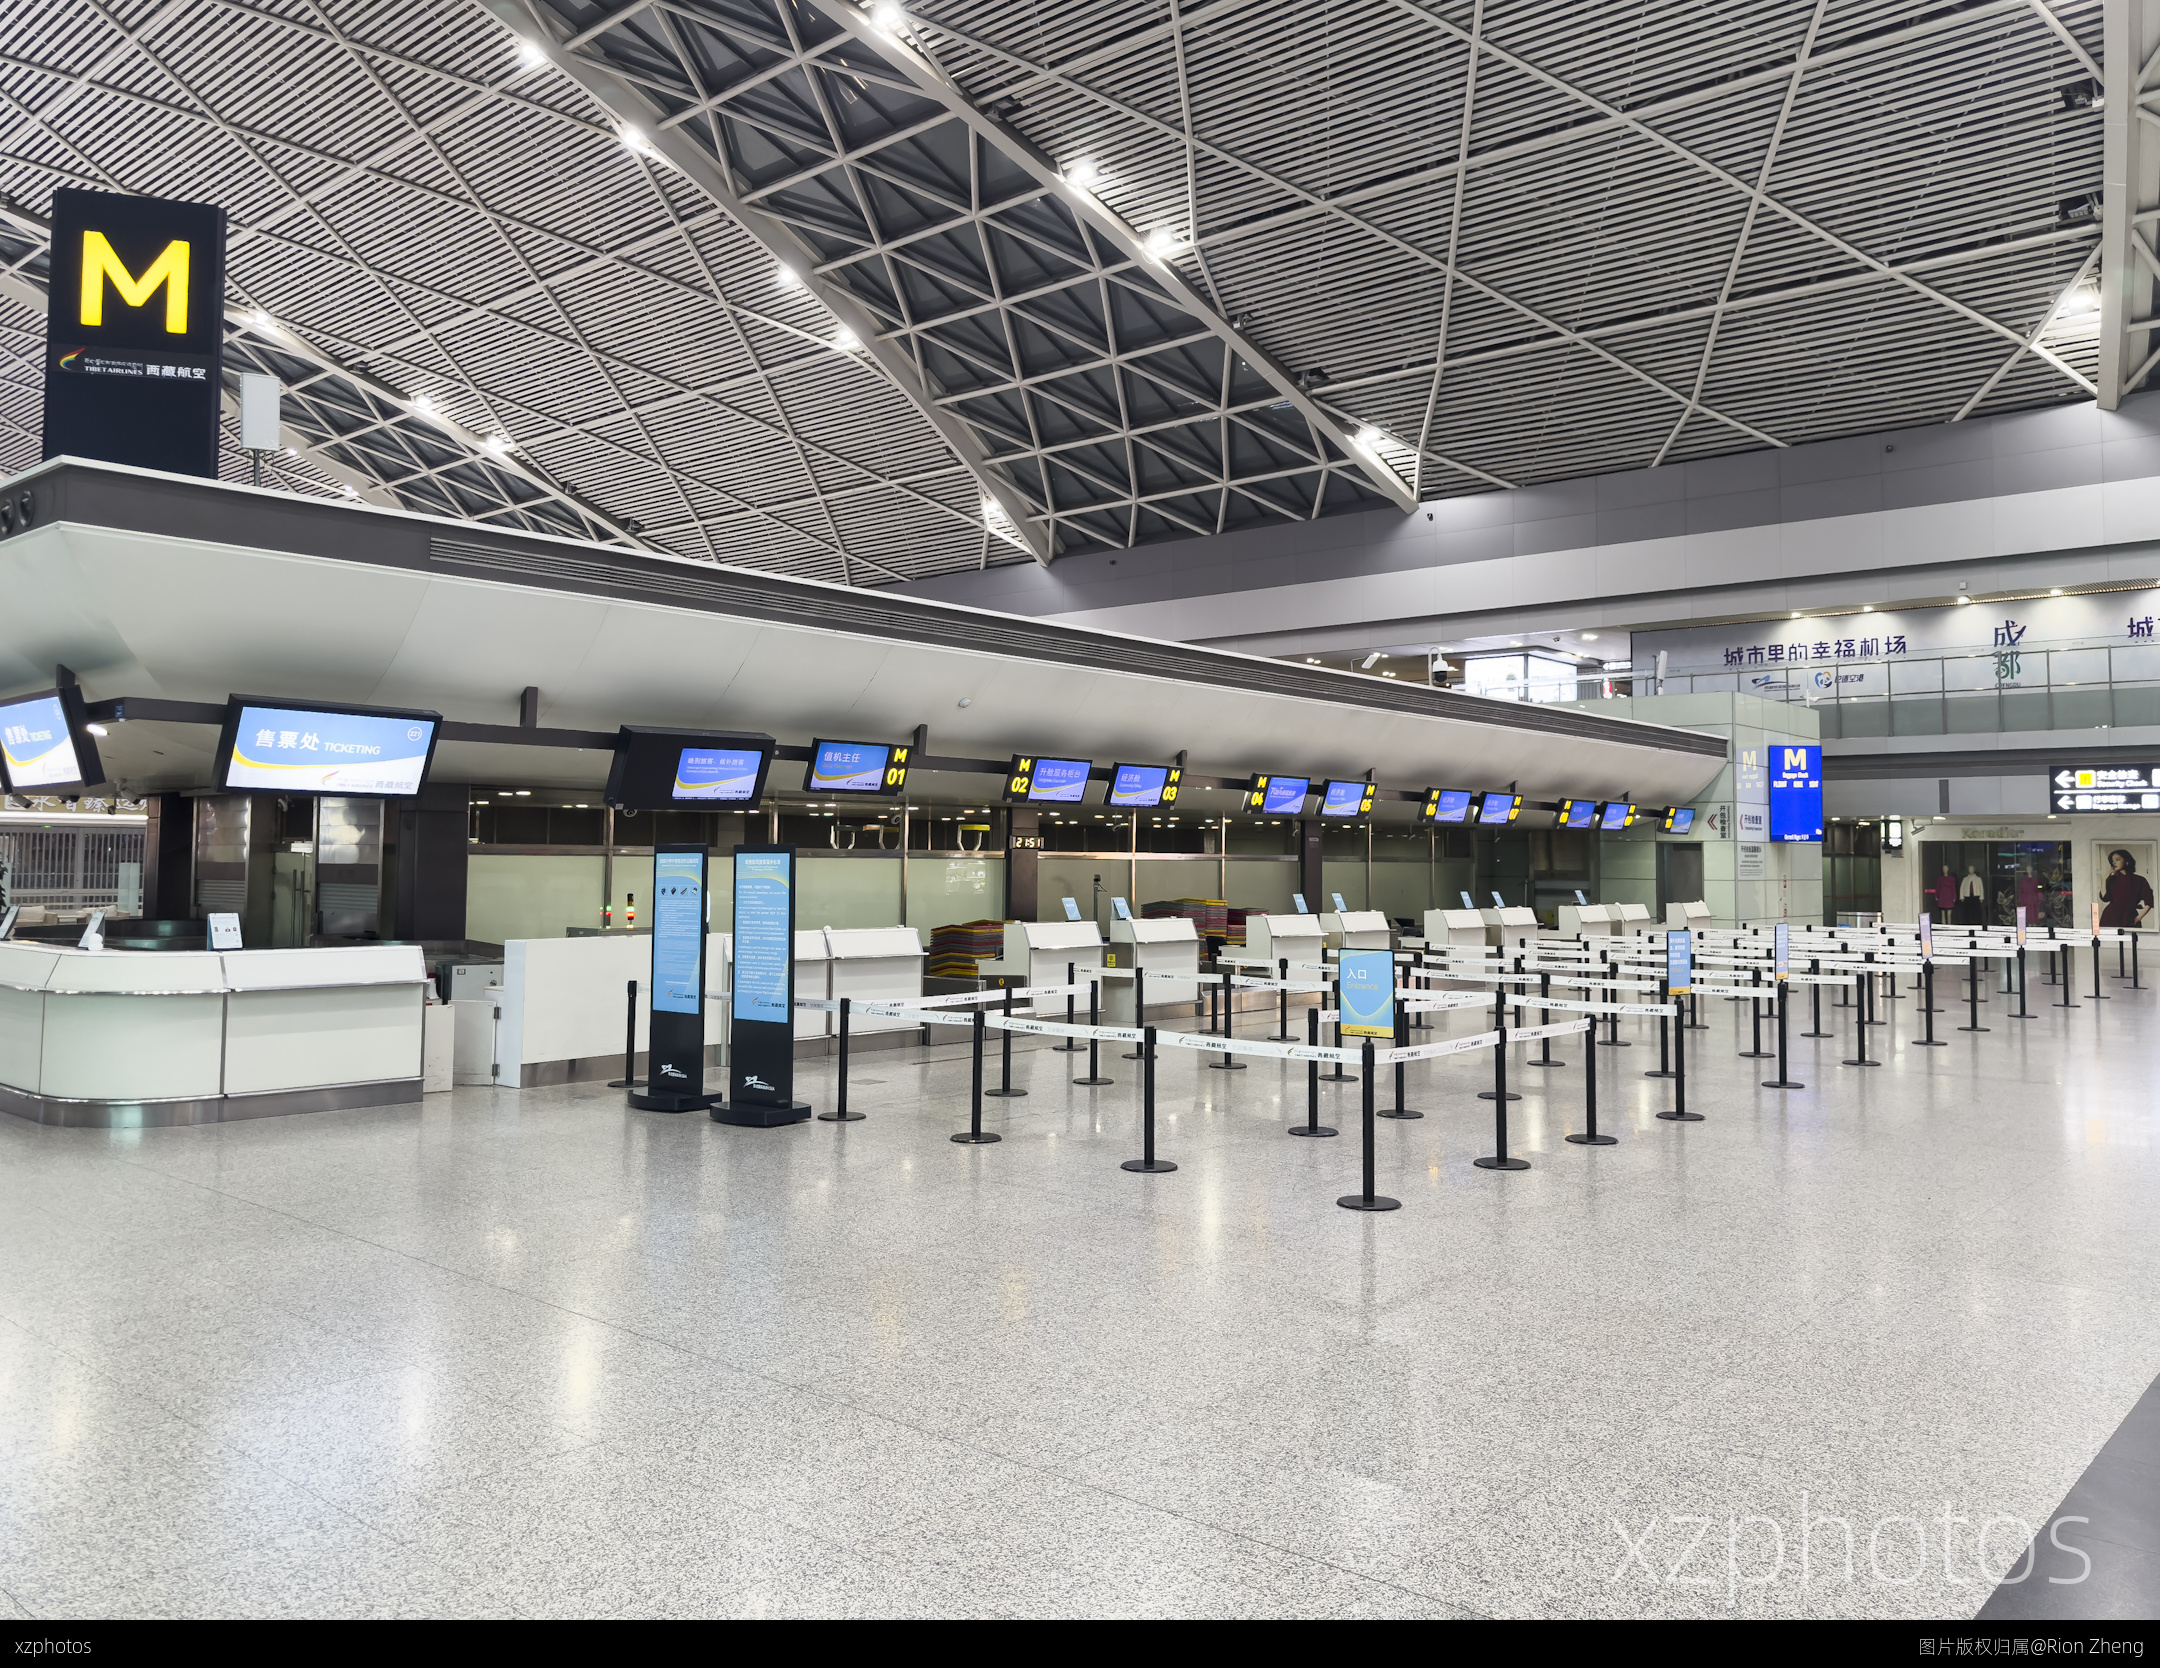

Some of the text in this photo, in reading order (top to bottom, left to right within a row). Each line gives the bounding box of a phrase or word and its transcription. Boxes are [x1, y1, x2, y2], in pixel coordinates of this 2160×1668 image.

[81, 230, 190, 334] M
[84, 365, 143, 376] TIBET AIRLINES
[146, 364, 206, 380] 西藏航空
[1723, 635, 1906, 666] 城市里的幸福机场
[409, 730, 421, 738] 221
[255, 728, 381, 755] 售票处 TICKETING
[824, 752, 860, 762] 值机主任
[894, 748, 908, 763] M
[1784, 748, 1807, 770] M
[1019, 758, 1032, 772] M
[887, 767, 906, 786] 01
[1169, 769, 1181, 783] M
[1257, 776, 1268, 788] M
[1011, 776, 1029, 794] 02
[1366, 785, 1375, 796] M
[1162, 786, 1178, 802] 03
[1251, 792, 1264, 806] 04
[1360, 798, 1373, 812] 05
[1016, 836, 1042, 848] 21:51
[1346, 968, 1366, 980] 入口
[1346, 981, 1378, 990] Entrance
